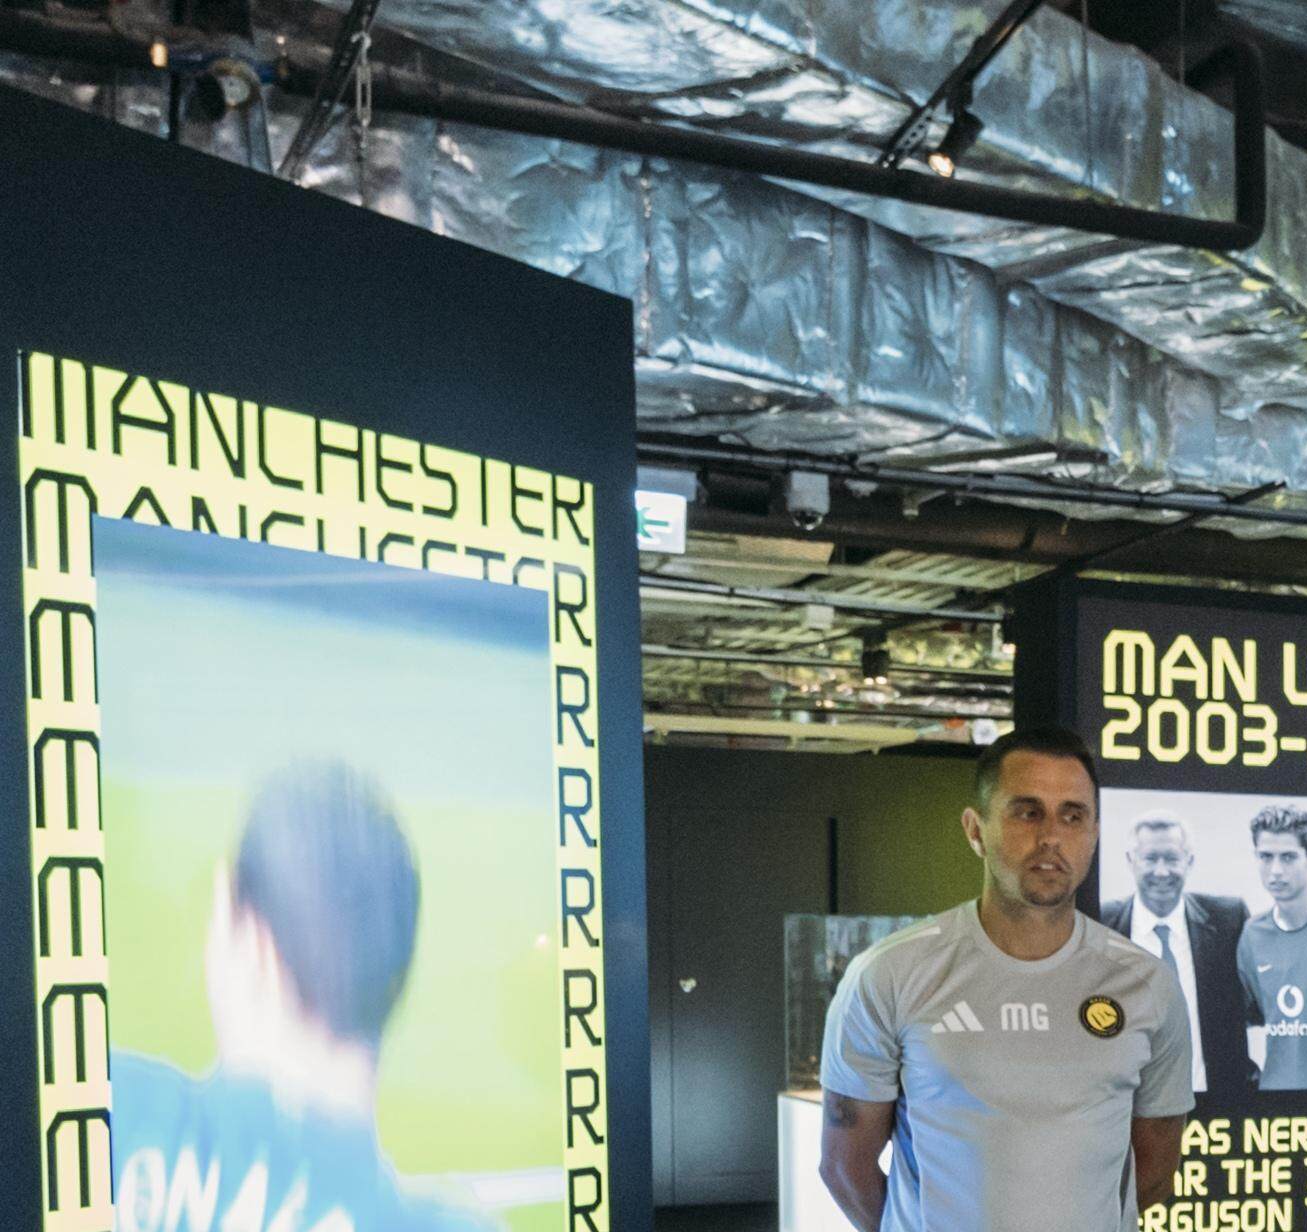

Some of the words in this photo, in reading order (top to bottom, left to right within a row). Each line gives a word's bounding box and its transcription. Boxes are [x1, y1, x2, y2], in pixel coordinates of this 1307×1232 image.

[22, 350, 592, 547] MANCHESTER
[1103, 628, 1257, 701] MAN
[1001, 1002, 1049, 1031] MG
[1181, 1118, 1231, 1156] AS
[1221, 1158, 1292, 1195] THE
